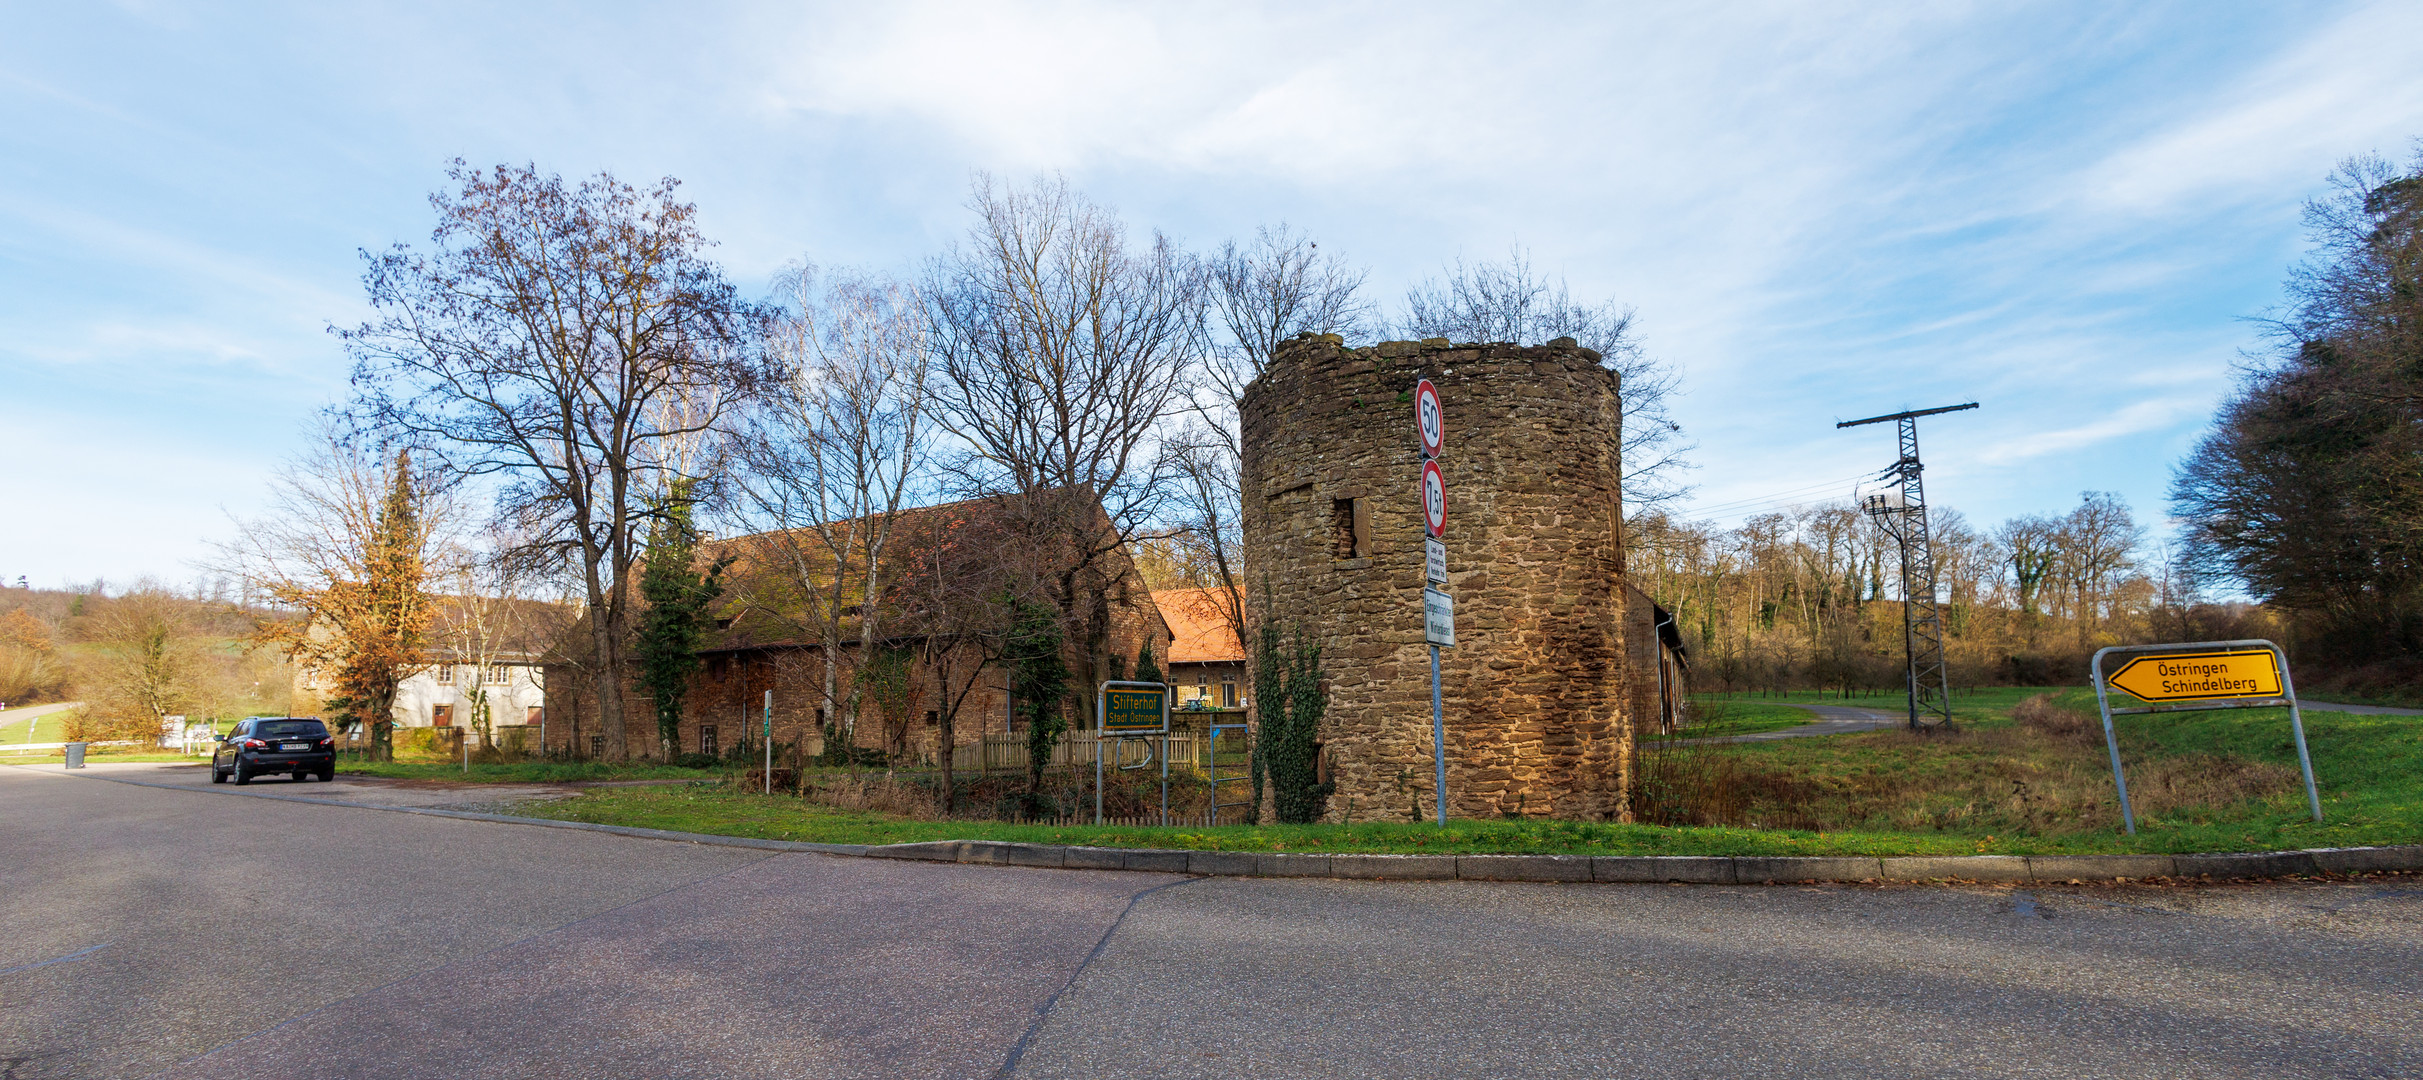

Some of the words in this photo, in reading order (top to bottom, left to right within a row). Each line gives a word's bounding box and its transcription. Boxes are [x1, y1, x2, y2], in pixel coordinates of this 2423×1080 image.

[1423, 399, 1438, 438] 50
[2158, 662, 2228, 677] Östringen
[2162, 679, 2257, 693] Schindelberg
[1113, 695, 1157, 710] Stifterhof
[1109, 712, 1128, 722] Stadt
[1130, 710, 1160, 725] Östringen
